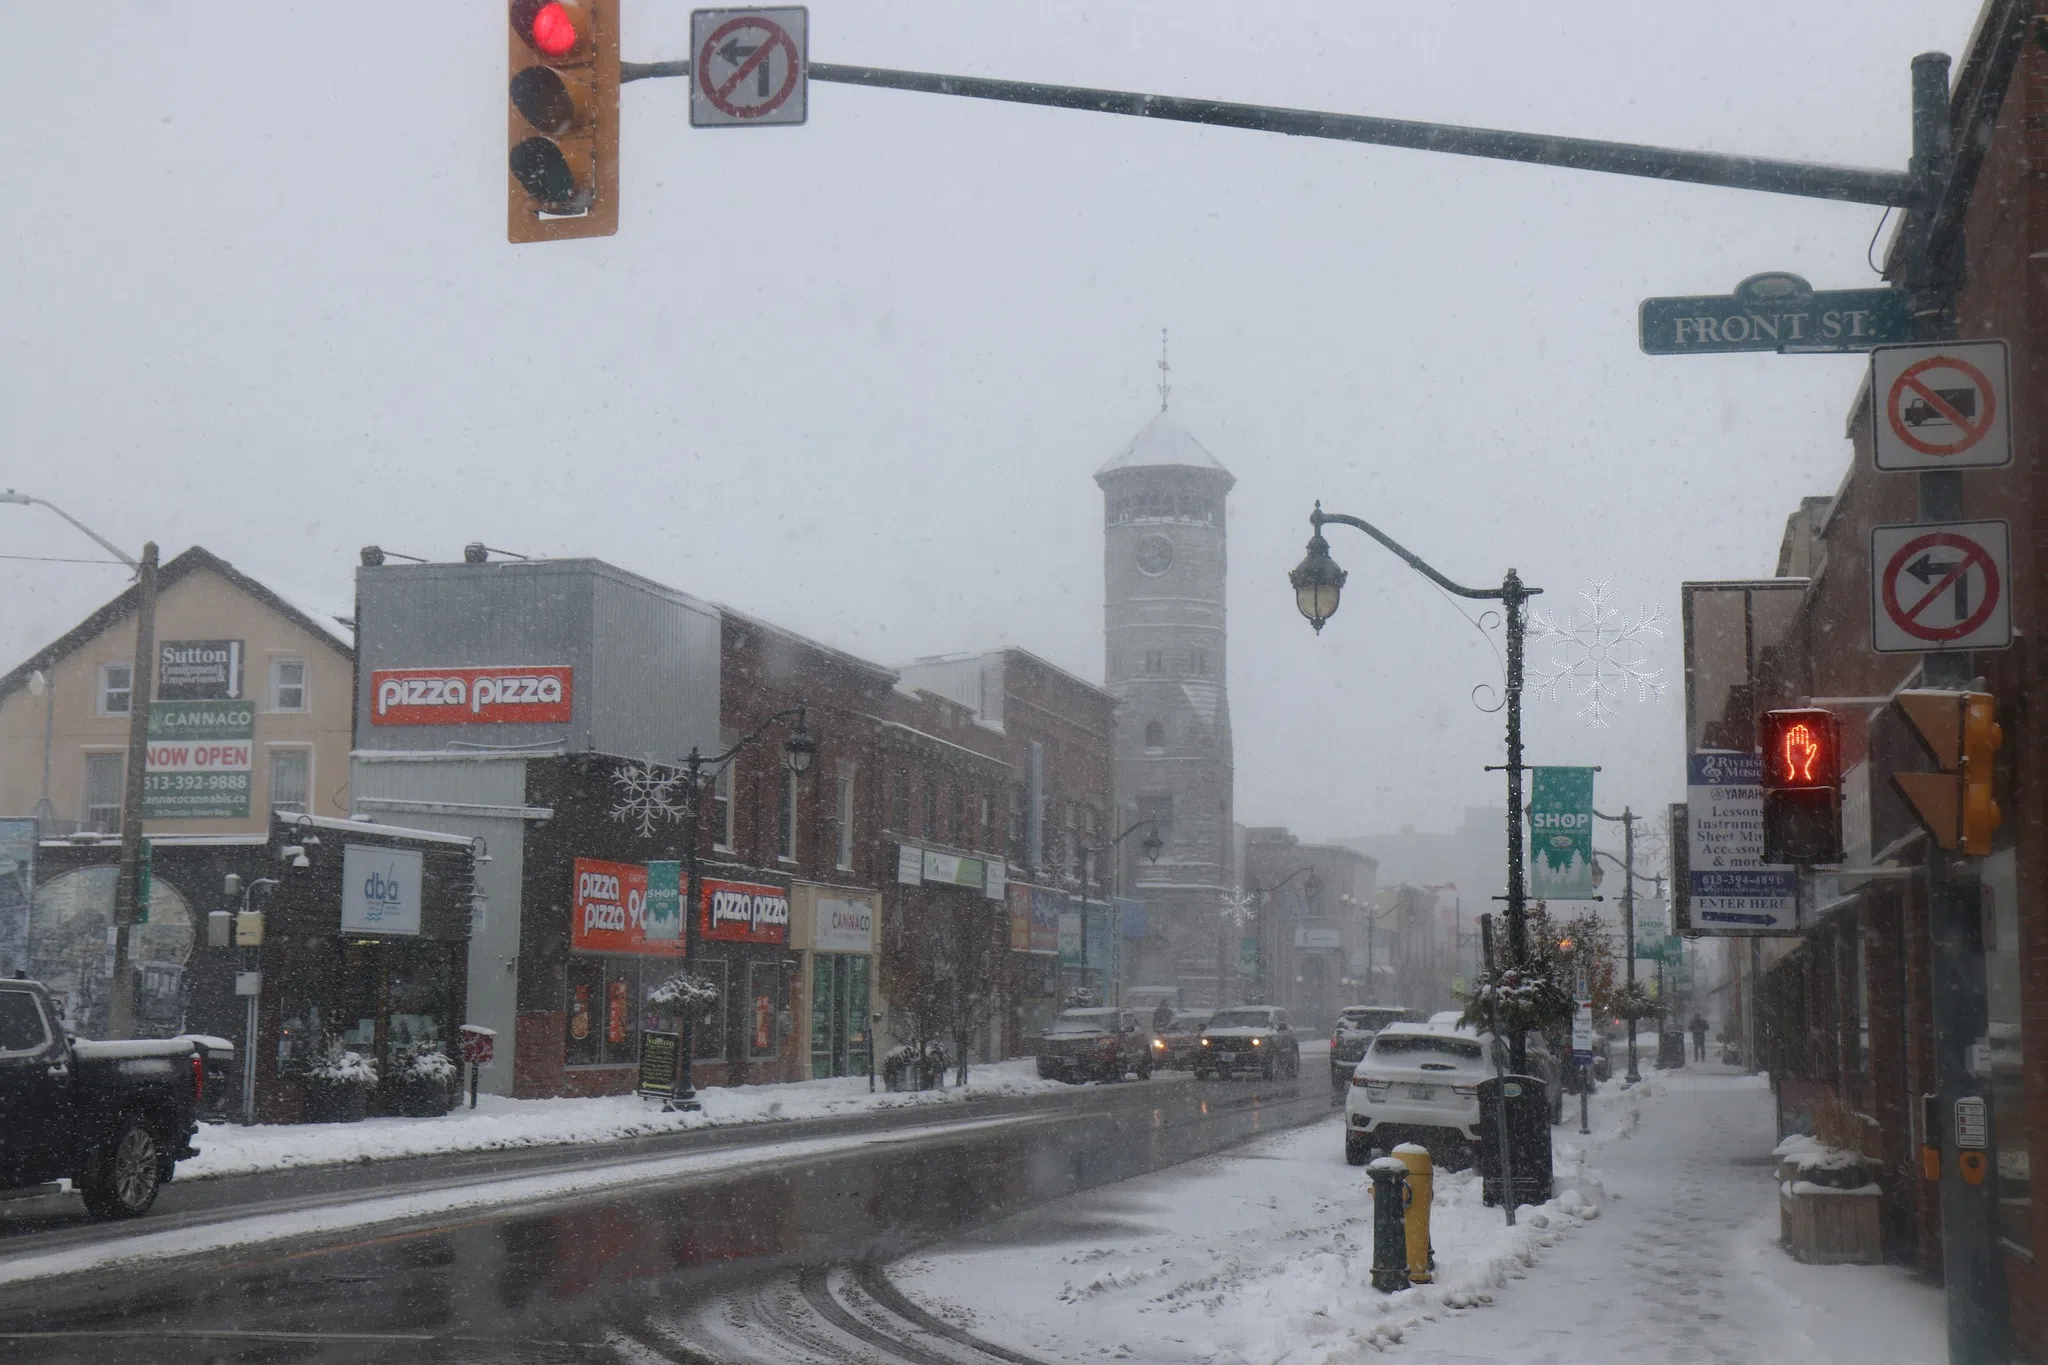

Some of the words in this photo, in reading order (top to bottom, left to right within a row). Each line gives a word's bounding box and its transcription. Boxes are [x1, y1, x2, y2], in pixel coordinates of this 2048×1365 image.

[1674, 313, 1809, 344] FRONT
[1822, 310, 1876, 338] ST.
[161, 647, 228, 664] Sutton
[379, 678, 467, 715] pizza
[472, 675, 562, 714] pizza
[164, 711, 251, 726] CANNACO
[146, 746, 189, 766] NOW
[194, 745, 248, 766] OPEN
[1719, 757, 1764, 768] RIVERSI
[1725, 788, 1763, 800] YAMAH
[1534, 813, 1589, 828] SHOP
[1698, 820, 1764, 830] Instrume
[1697, 831, 1734, 842] Sheet
[1702, 844, 1764, 855] Accessor
[1713, 856, 1724, 867] &
[578, 872, 619, 907] pizza
[648, 889, 677, 898] SHOP
[713, 890, 750, 928] pizza
[752, 895, 788, 932] pizza
[1700, 899, 1745, 909] ENTER
[1750, 899, 1789, 909] HERE
[584, 903, 625, 937] pizza
[832, 911, 871, 931] CANNACO
[1637, 920, 1664, 929] SHOP
